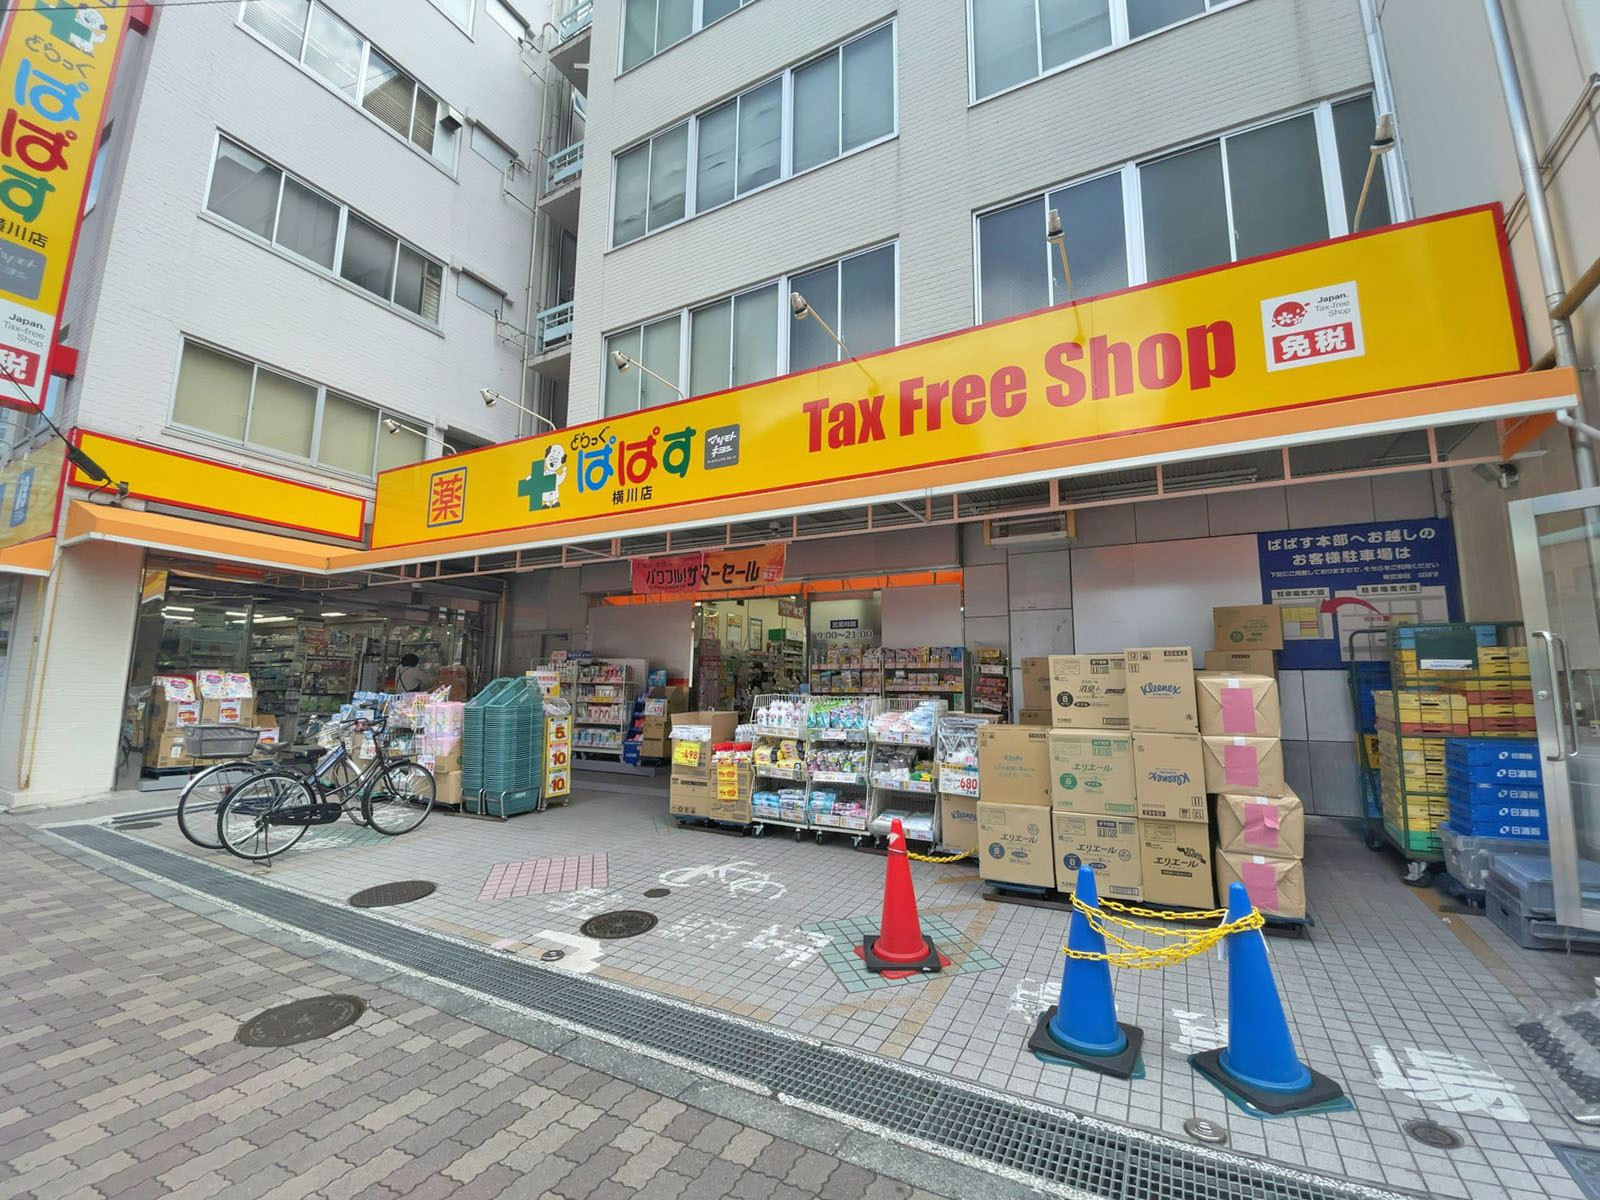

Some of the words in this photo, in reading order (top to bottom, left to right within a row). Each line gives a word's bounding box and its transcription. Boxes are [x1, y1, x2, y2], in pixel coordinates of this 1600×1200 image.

[1317, 292, 1349, 304] Japan.
[1314, 300, 1350, 313] Tax-free
[1328, 307, 1352, 317] Shop
[9, 313, 46, 331] Japan.
[3, 320, 45, 340] Tax-free
[16, 333, 44, 348] Shop
[1280, 326, 1347, 360] 免税
[803, 394, 886, 453] Tax
[900, 363, 1027, 438] Free
[1045, 318, 1237, 408] Shop
[707, 431, 737, 446] マツモト
[711, 445, 734, 458] キヨシ
[577, 426, 697, 494] ぱぱす
[431, 473, 463, 522] 薬
[612, 485, 653, 506] 横川店
[1292, 547, 1411, 567] お客様駐車場は
[1140, 682, 1182, 696] Kleenex
[1072, 763, 1113, 773] エリエール
[960, 778, 978, 790] 680
[1148, 771, 1191, 786] Kleenex
[1000, 834, 1038, 844] エリエール
[1077, 843, 1118, 855] エリエール
[1153, 856, 1199, 869] エリエール
